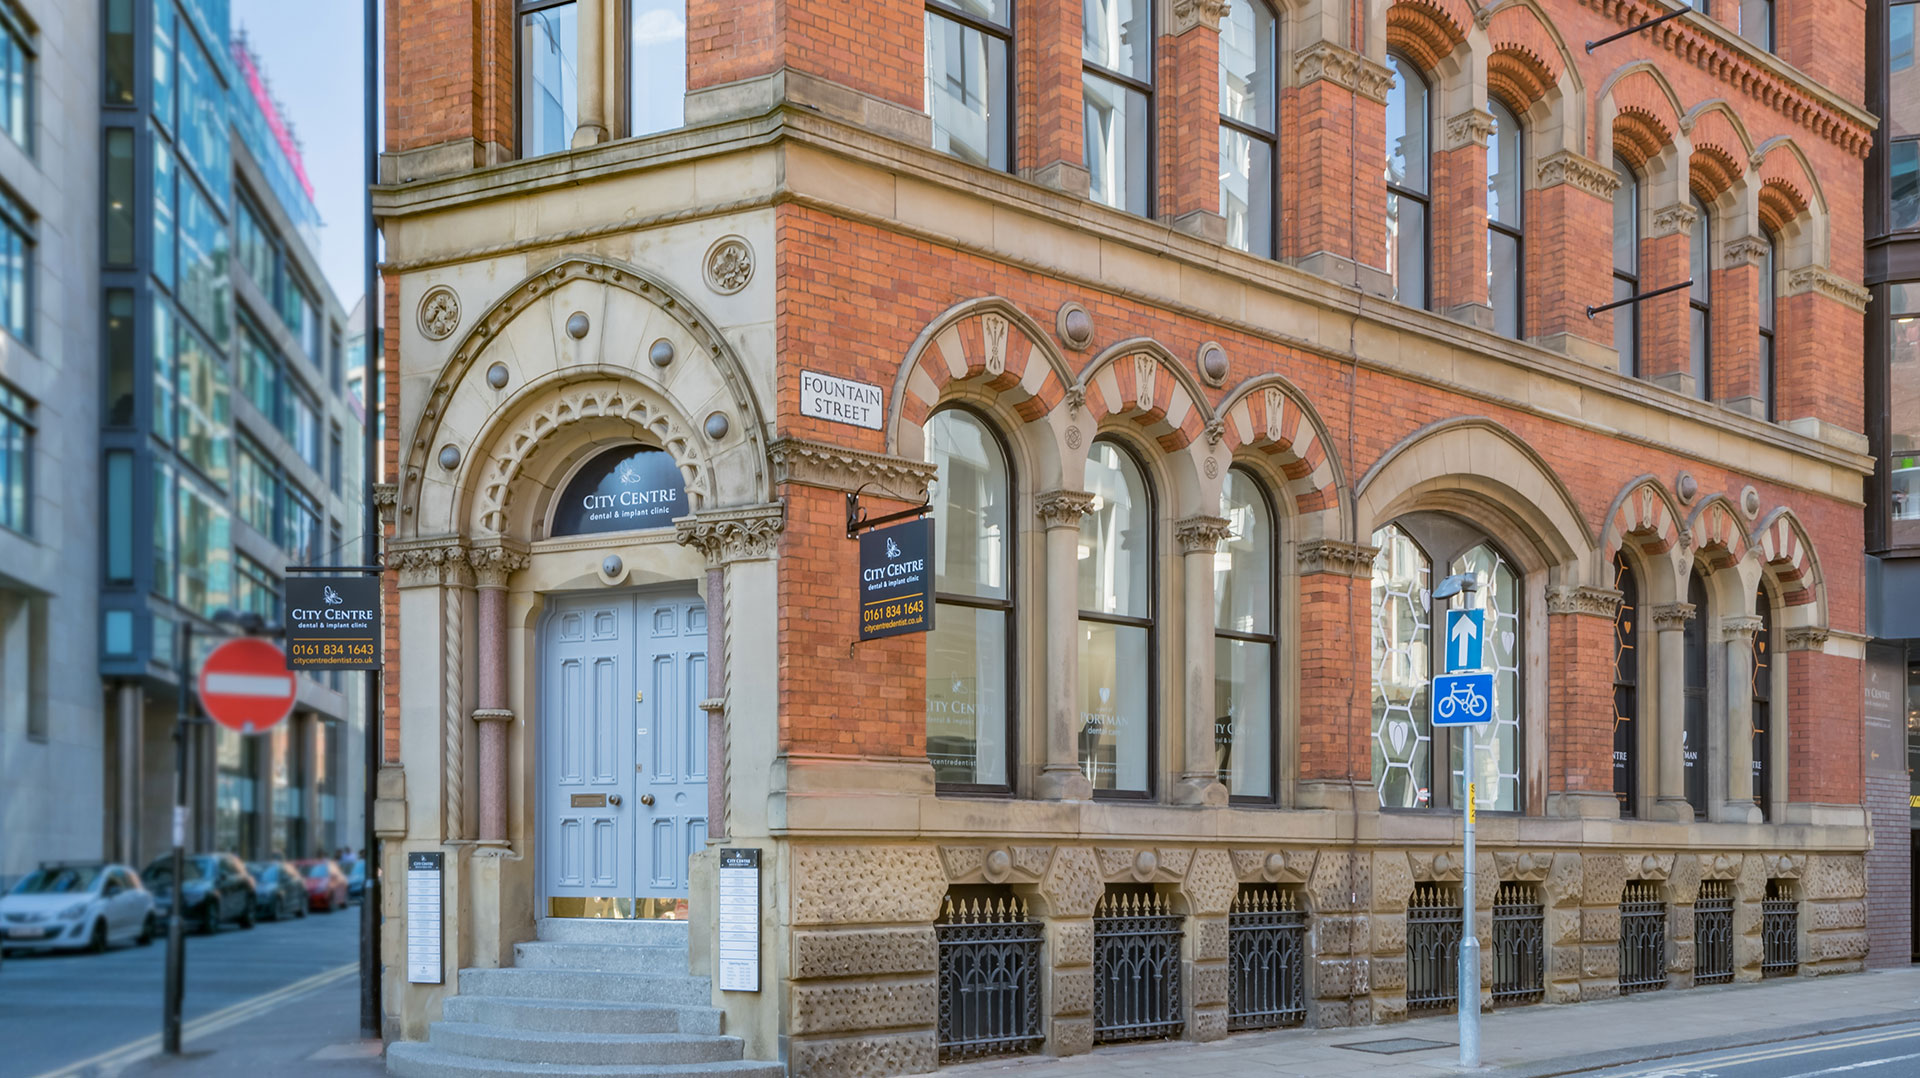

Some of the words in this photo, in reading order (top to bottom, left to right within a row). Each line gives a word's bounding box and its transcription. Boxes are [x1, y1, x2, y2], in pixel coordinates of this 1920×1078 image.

[804, 376, 880, 406] FOUNTAIN
[815, 397, 870, 422] STREET
[590, 511, 612, 520] dental
[614, 510, 619, 518] &
[622, 509, 648, 519] implant
[650, 506, 670, 514] clinic
[868, 582, 883, 591] dental
[883, 580, 888, 588] &
[888, 577, 906, 588] implant
[906, 574, 920, 583] clinic
[864, 607, 884, 622] 0161
[886, 604, 902, 618] 834
[903, 600, 924, 615] 1643
[326, 622, 349, 630] implant
[864, 615, 923, 633] citycentredentist.co.uk
[292, 644, 319, 655] 0161
[323, 644, 344, 655] 834
[347, 644, 374, 655] 1643
[293, 656, 373, 665] citycentredentist.co.uk
